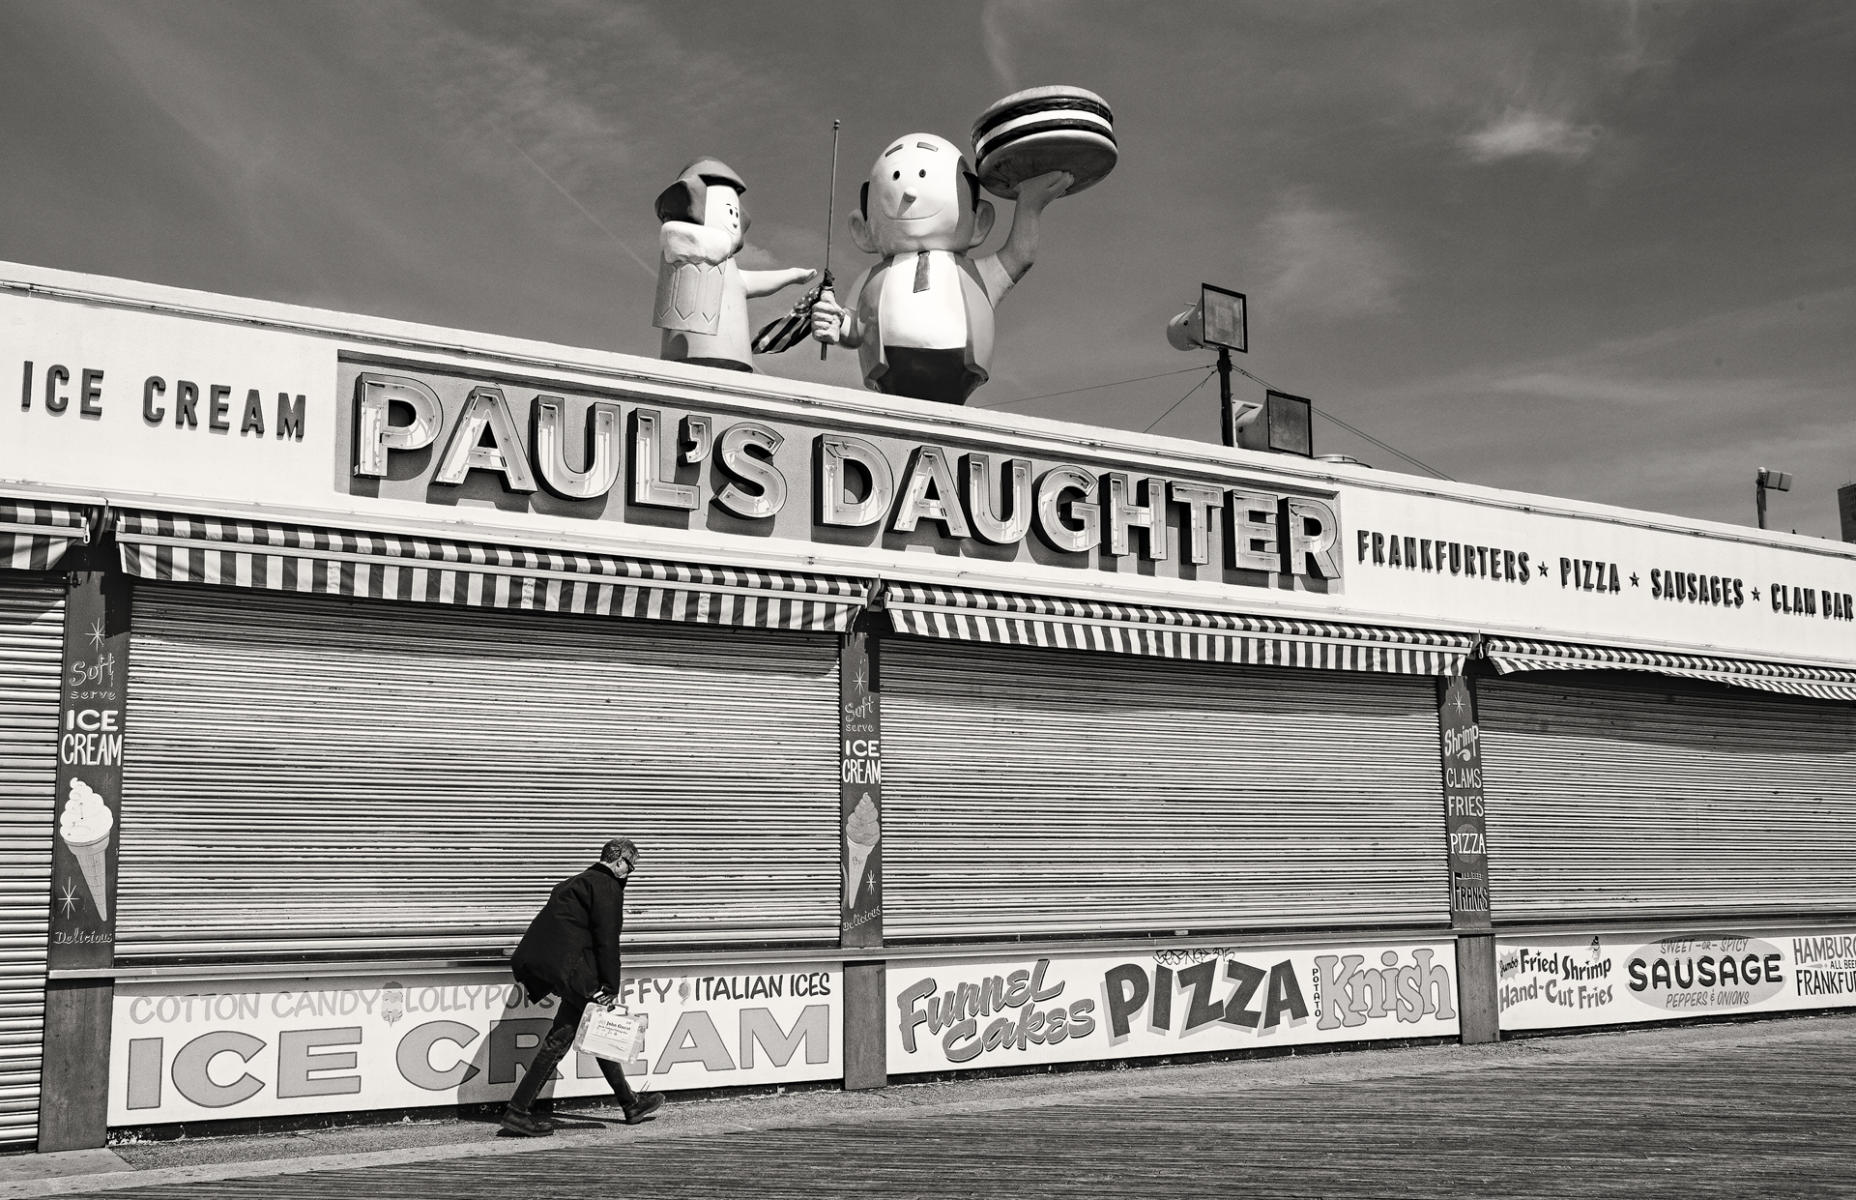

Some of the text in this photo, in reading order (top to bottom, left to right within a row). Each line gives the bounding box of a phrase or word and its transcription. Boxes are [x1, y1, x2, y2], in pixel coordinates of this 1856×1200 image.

[21, 360, 306, 441] ICE CREAM
[354, 372, 1341, 579] PAUL'S DAUGHTER
[1358, 529, 1854, 621] FRANKFURTERS PIZZA SAUSAGES CLAM BAR
[69, 652, 115, 687] Soft
[70, 690, 116, 700] serve
[66, 709, 119, 731] ICE
[845, 695, 875, 722] Soft
[845, 723, 875, 733] serve
[1444, 723, 1479, 757] Shrimp
[61, 734, 122, 766] CREAM
[845, 739, 880, 757] ICE
[842, 759, 881, 784] CREAM
[1446, 767, 1482, 789] CLAMS
[1448, 795, 1484, 817] FRIES
[1450, 833, 1487, 855] PIZZA
[842, 905, 881, 931] Delicious
[53, 927, 113, 944] Delicious
[1660, 938, 1693, 954] SWEET
[1720, 938, 1749, 953] SPICY
[1520, 948, 1558, 974] Fried
[1562, 955, 1611, 980] Shrimp
[1627, 953, 1783, 991] SAUSAGE
[1831, 961, 1843, 969] ALL
[129, 993, 262, 1024] COTTON
[271, 987, 384, 1018] CANDY
[695, 975, 783, 1001] ITALIAN
[790, 972, 832, 998] ICES
[1101, 958, 1309, 1045] PIZZA
[1312, 968, 1321, 1017] POTATO
[1314, 948, 1456, 1030] Knish
[1578, 984, 1613, 1009] Fries
[1666, 991, 1708, 1008] PEPPERS
[1717, 990, 1750, 1006] ONIONS
[126, 1026, 363, 1110] ICE
